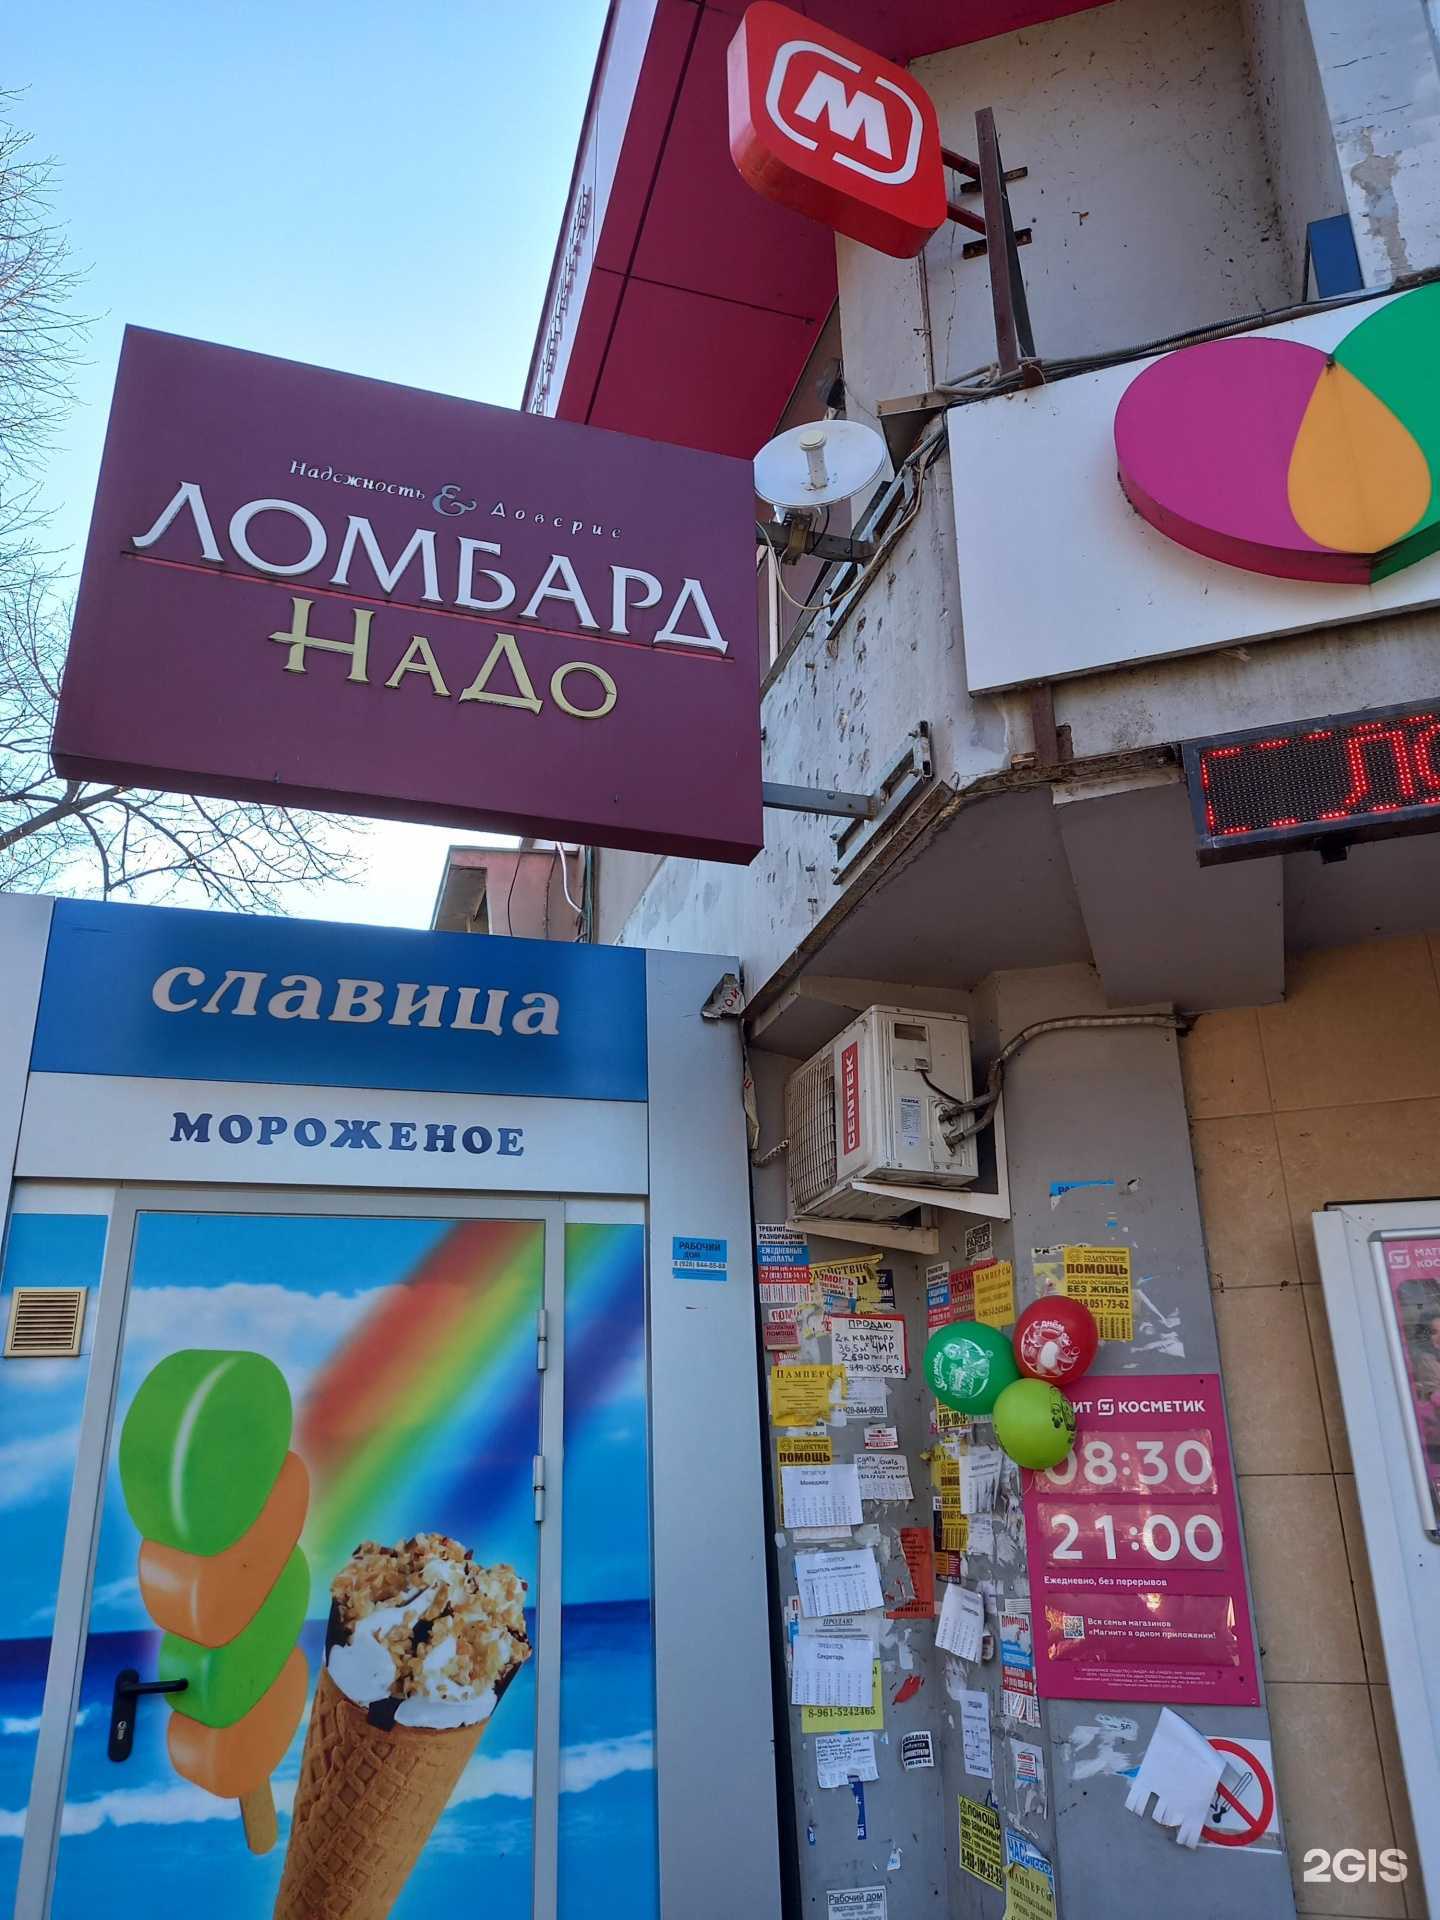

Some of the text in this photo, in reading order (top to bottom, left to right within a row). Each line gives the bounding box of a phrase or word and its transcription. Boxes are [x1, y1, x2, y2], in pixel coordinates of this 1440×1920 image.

[132, 482, 729, 656] ЛОМБАРД
[847, 1055, 858, 1149] CENTEK
[169, 1112, 525, 1157] МОРОЖЕНОЕ
[1066, 1264, 1128, 1276] ПОМОЩЬ
[1067, 1285, 1128, 1294] БЕЗ ЖИЛЬЯ
[849, 1320, 892, 1329] ПРОДАЮ
[1118, 1399, 1206, 1414] КОСМЕТИК
[779, 1452, 831, 1464] ПОМОЩЬ
[1050, 1513, 1224, 1562] 21:00
[1044, 1576, 1167, 1587] Ежедневно, без перерывов
[1087, 1617, 1171, 1628] Вся семья магазинов
[1162, 1631, 1216, 1640] приложении!
[829, 1891, 883, 1905] Рабочий дом
